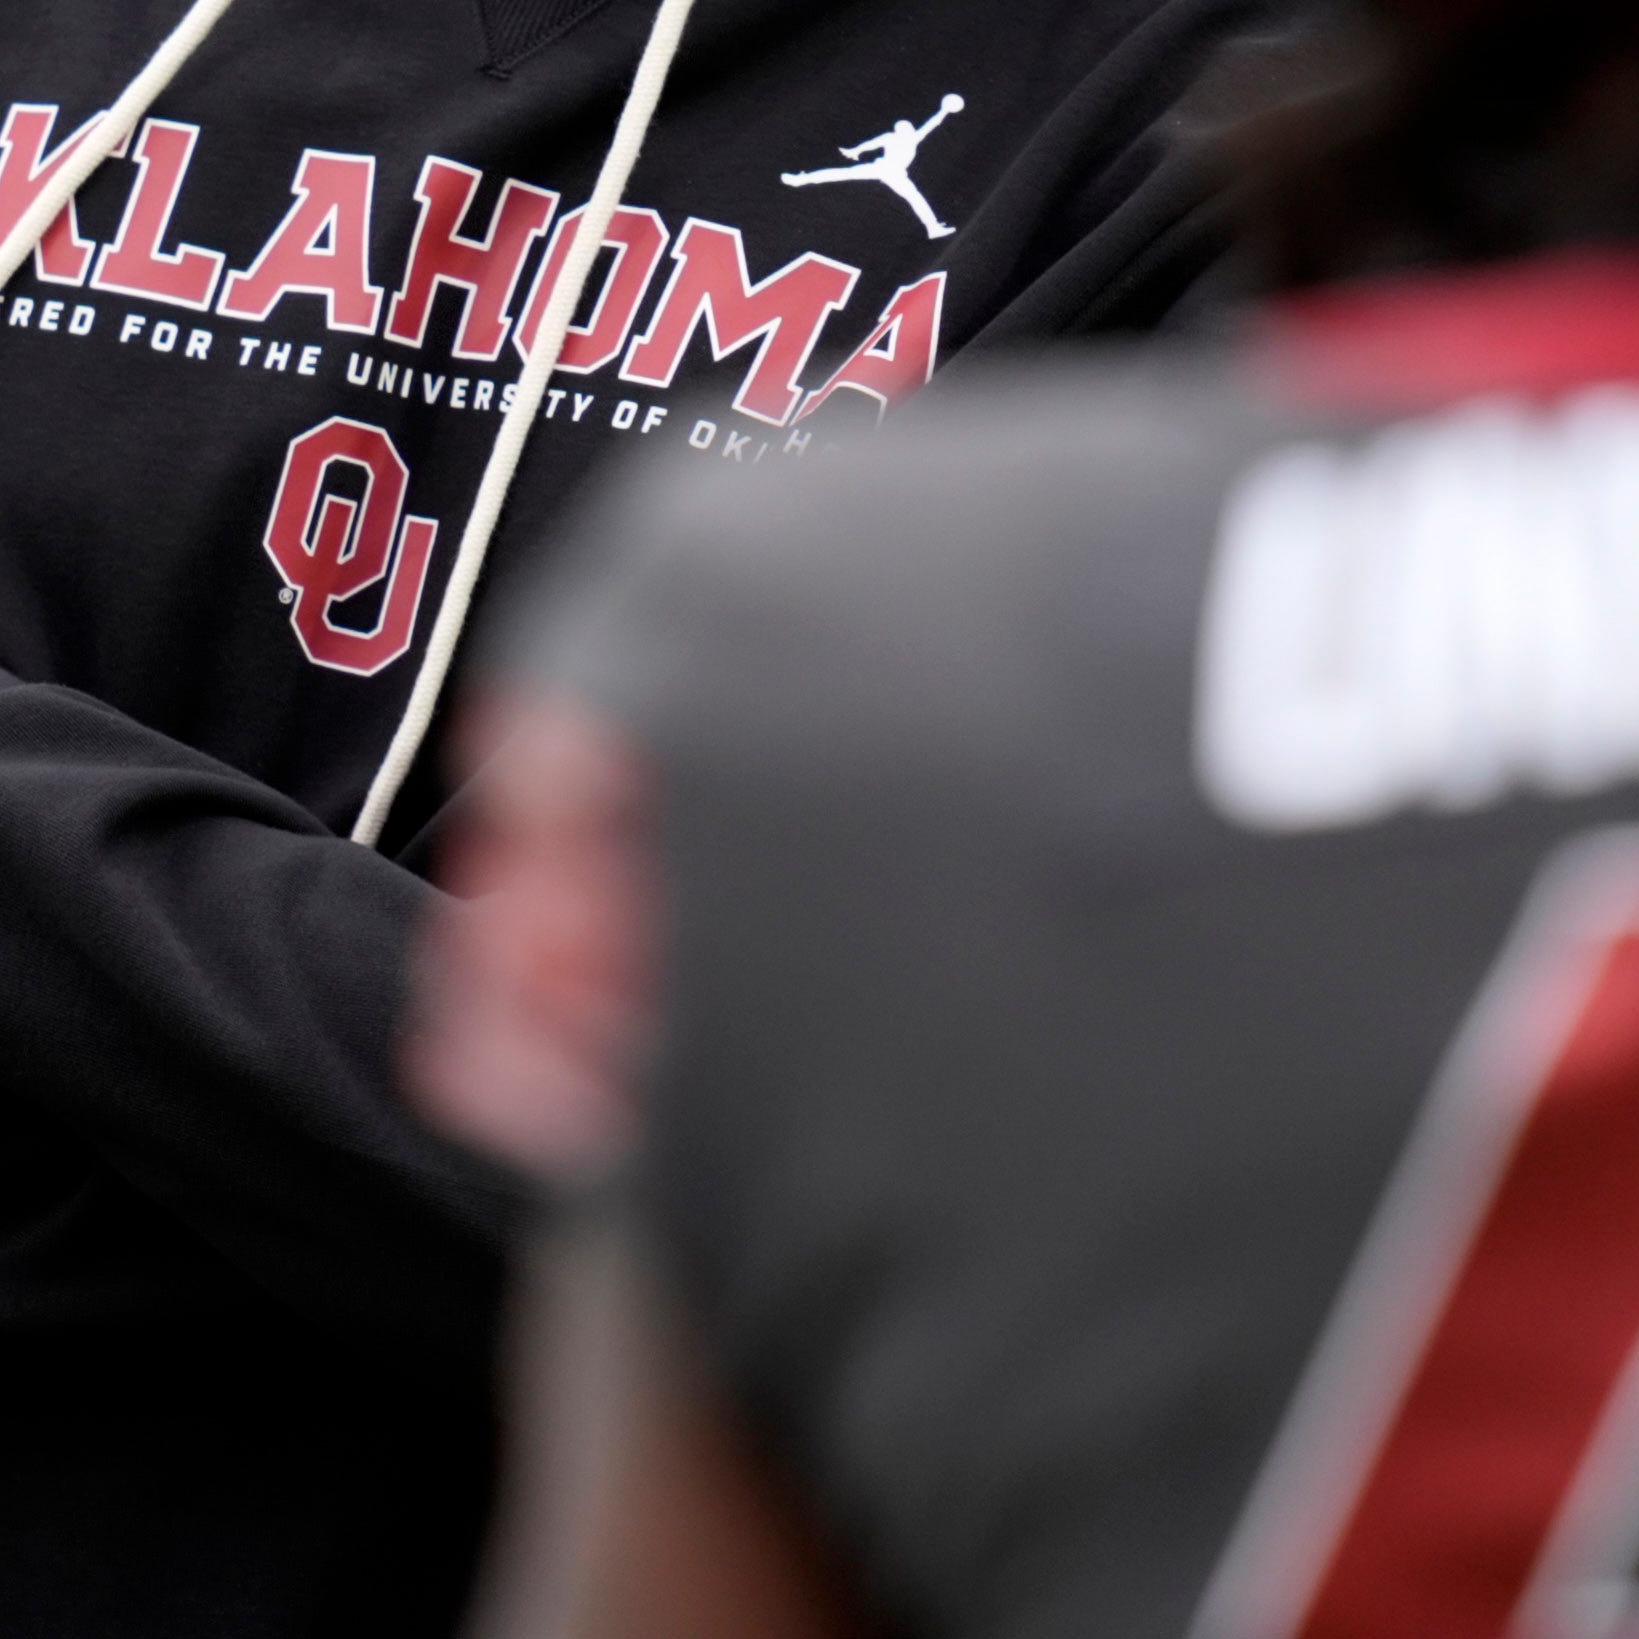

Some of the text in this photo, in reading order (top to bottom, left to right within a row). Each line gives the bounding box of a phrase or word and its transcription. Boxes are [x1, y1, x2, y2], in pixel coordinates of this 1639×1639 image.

[119, 314, 215, 360] FOR
[239, 337, 322, 376] THE
[347, 352, 594, 422] UNIVERSTY
[611, 399, 668, 434] OF
[262, 415, 439, 677] OU
